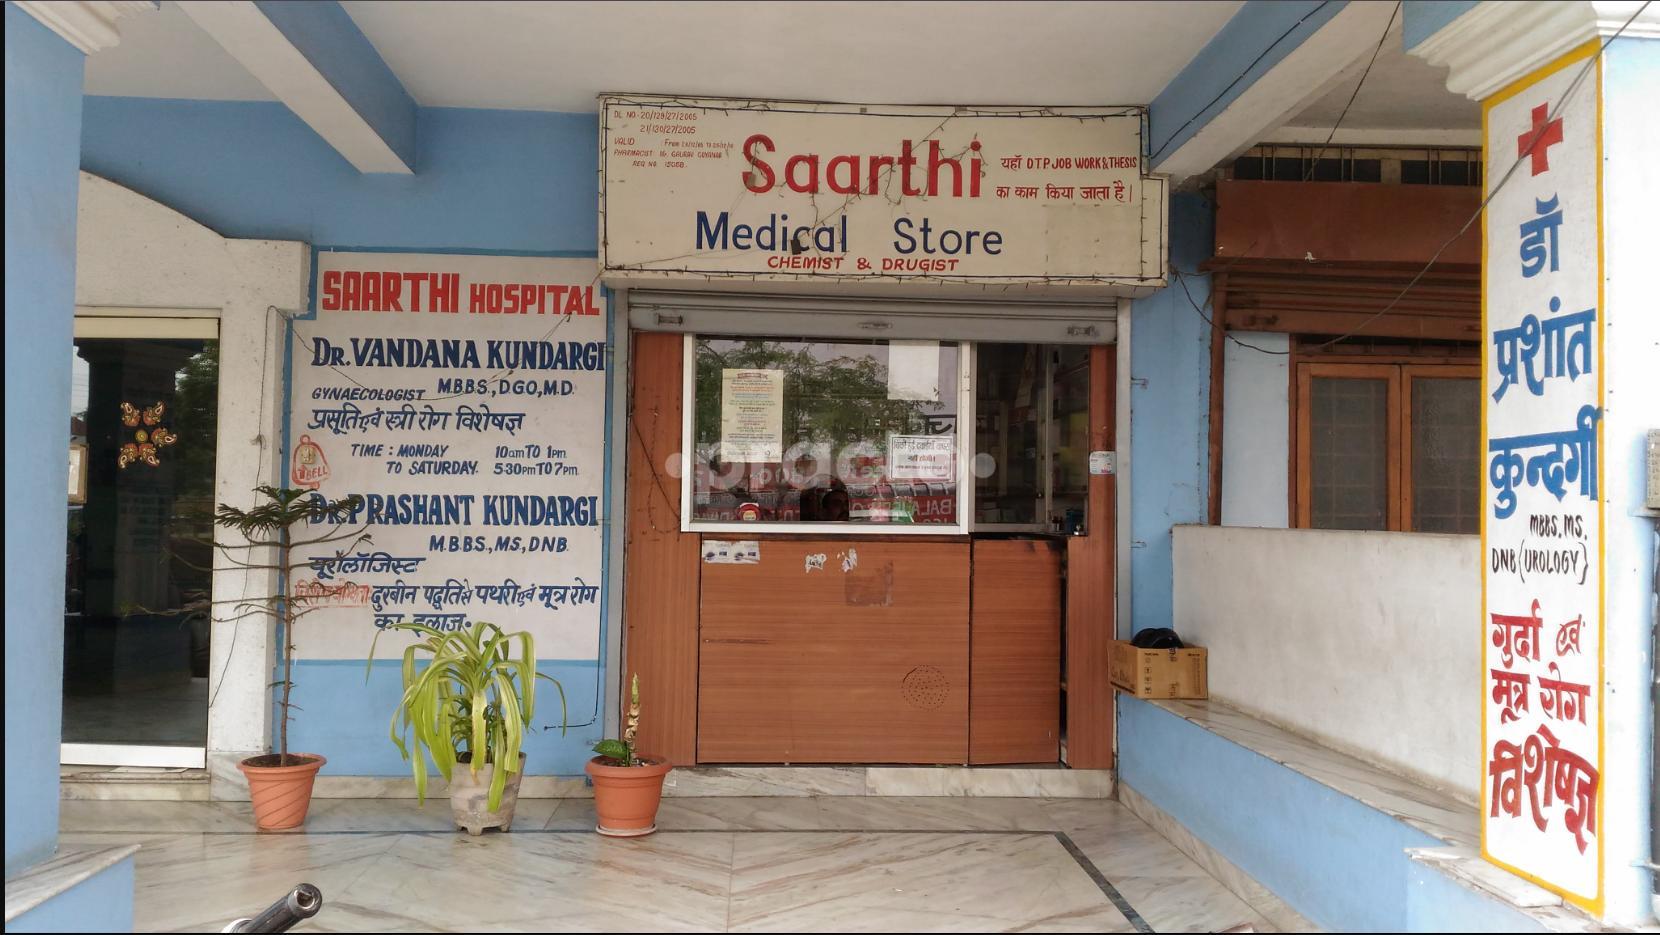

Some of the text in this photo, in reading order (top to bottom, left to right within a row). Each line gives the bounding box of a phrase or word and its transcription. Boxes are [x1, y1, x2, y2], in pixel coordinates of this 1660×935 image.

[614, 137, 635, 145] VALID
[742, 134, 981, 197] Saarthi
[1052, 157, 1072, 169] JOB
[996, 186, 1011, 199] का
[1015, 187, 1039, 199] काम
[1045, 183, 1075, 199] किया
[1080, 186, 1110, 201] जाता
[696, 210, 1003, 255] Medical Store
[767, 255, 959, 271] CHEMIST & DRUGIST
[322, 270, 600, 316] SAARTHI HOSPITAL
[487, 340, 606, 371] KUNDARGI
[1493, 296, 1596, 403] प्रशांत
[312, 388, 426, 402] GYNAECOLOGIST
[385, 404, 417, 431] स्त्री
[419, 405, 451, 431] रोग
[455, 404, 526, 436] विशेषज्ञ
[351, 443, 384, 457] TIME
[397, 444, 449, 458] MONDAY
[387, 461, 402, 475] TO
[483, 495, 599, 526] KUNDARGI
[538, 585, 572, 611] मूत्र
[570, 577, 599, 605] रोग
[1490, 661, 1591, 726] मूत्र रोग
